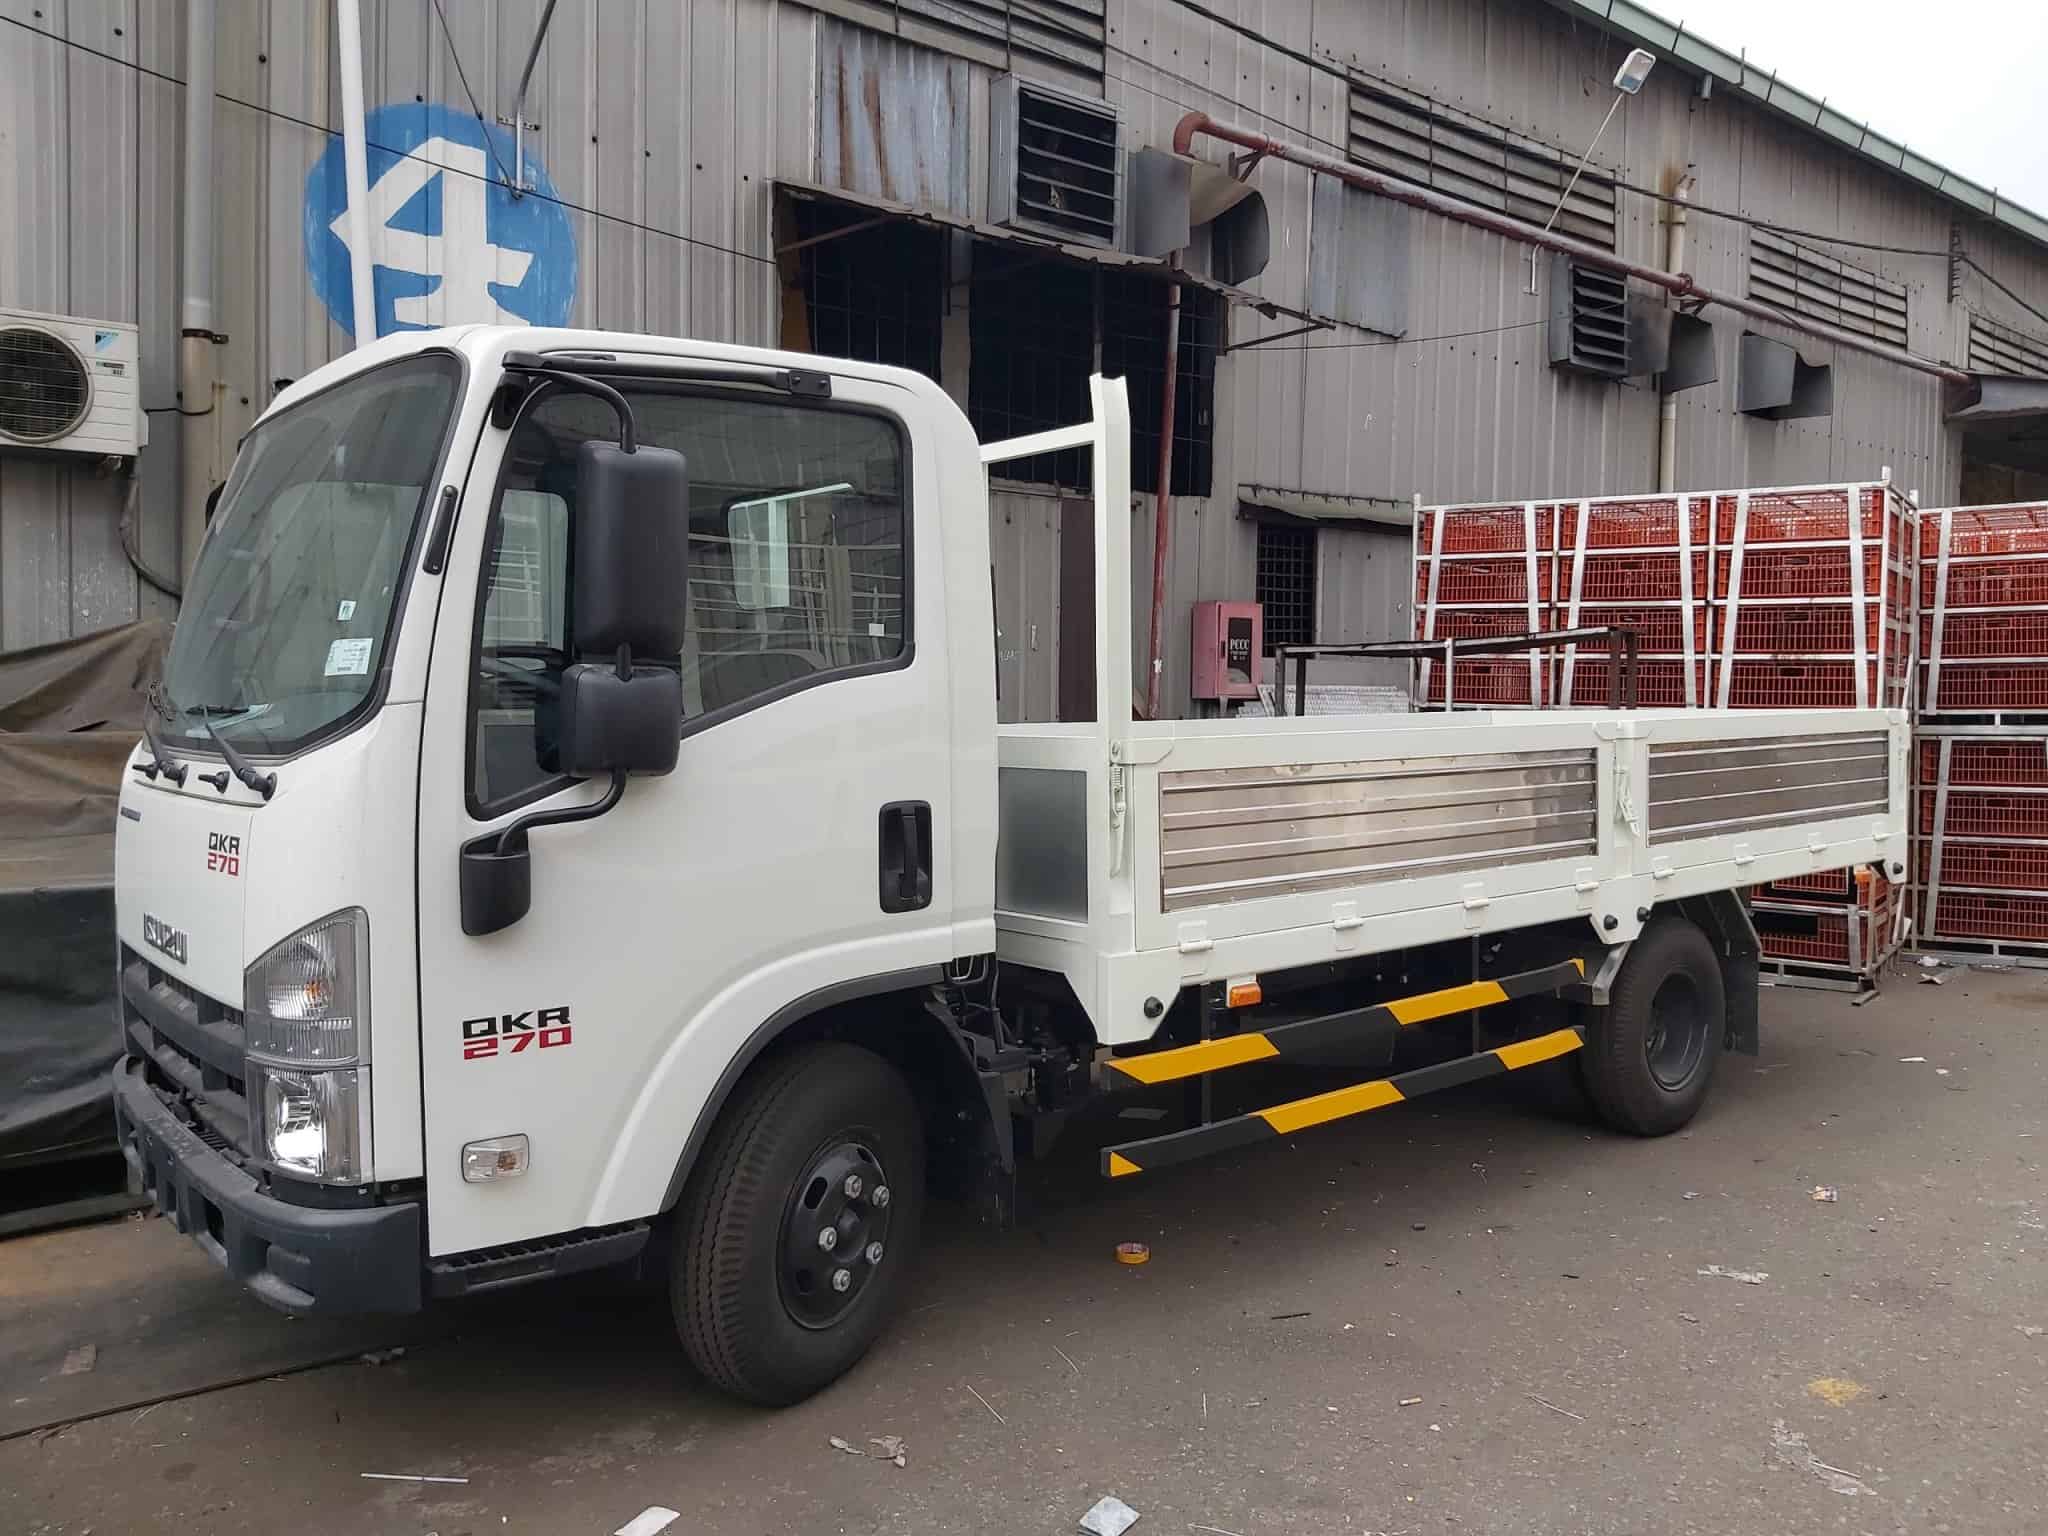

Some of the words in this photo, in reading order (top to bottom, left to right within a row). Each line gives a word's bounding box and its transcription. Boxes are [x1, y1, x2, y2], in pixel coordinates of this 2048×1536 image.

[329, 136, 534, 326] 4
[208, 831, 240, 855] QKR
[207, 852, 240, 877] 270
[143, 912, 188, 965] ISUZU
[462, 1006, 571, 1039] QKR
[463, 1026, 572, 1060] 270
